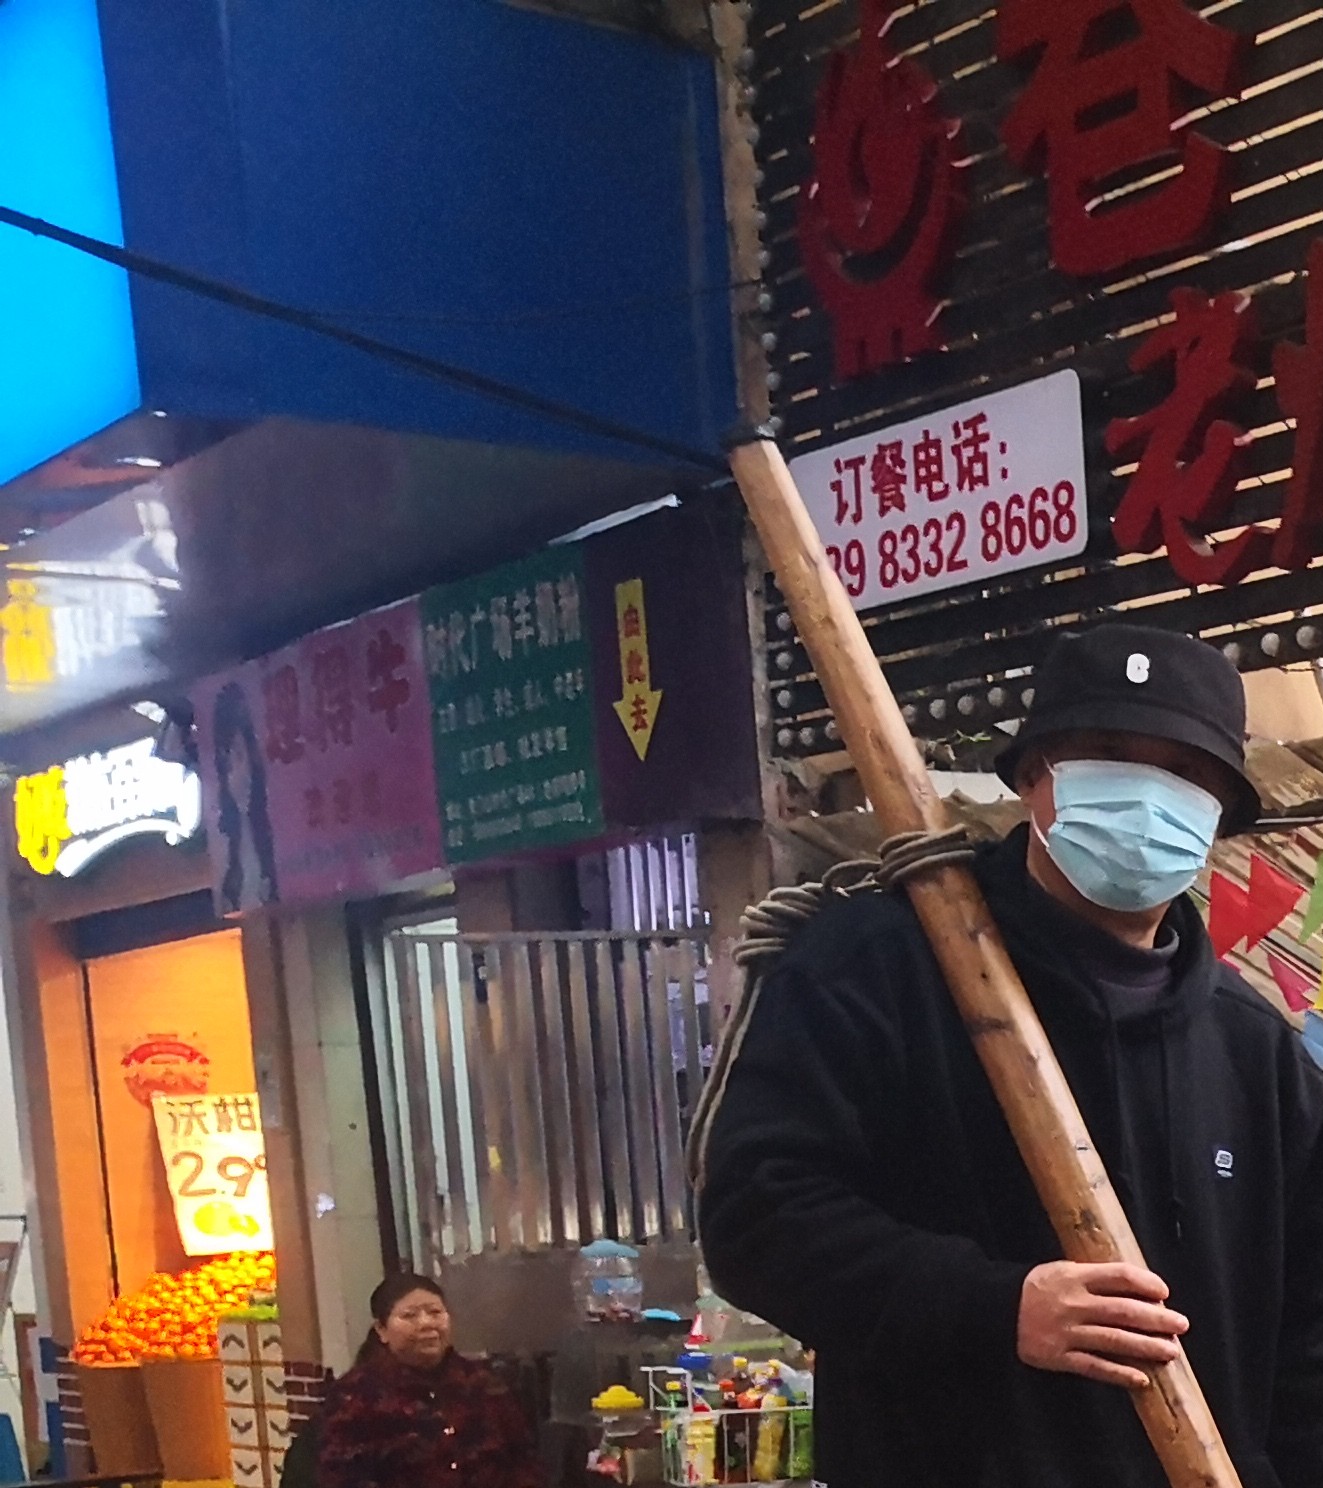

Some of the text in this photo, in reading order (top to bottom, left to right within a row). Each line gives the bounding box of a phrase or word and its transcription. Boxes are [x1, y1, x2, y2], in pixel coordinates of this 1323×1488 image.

[829, 411, 1009, 527] 订餐电话：
[877, 510, 969, 589] 8332
[980, 480, 1077, 563] 8668
